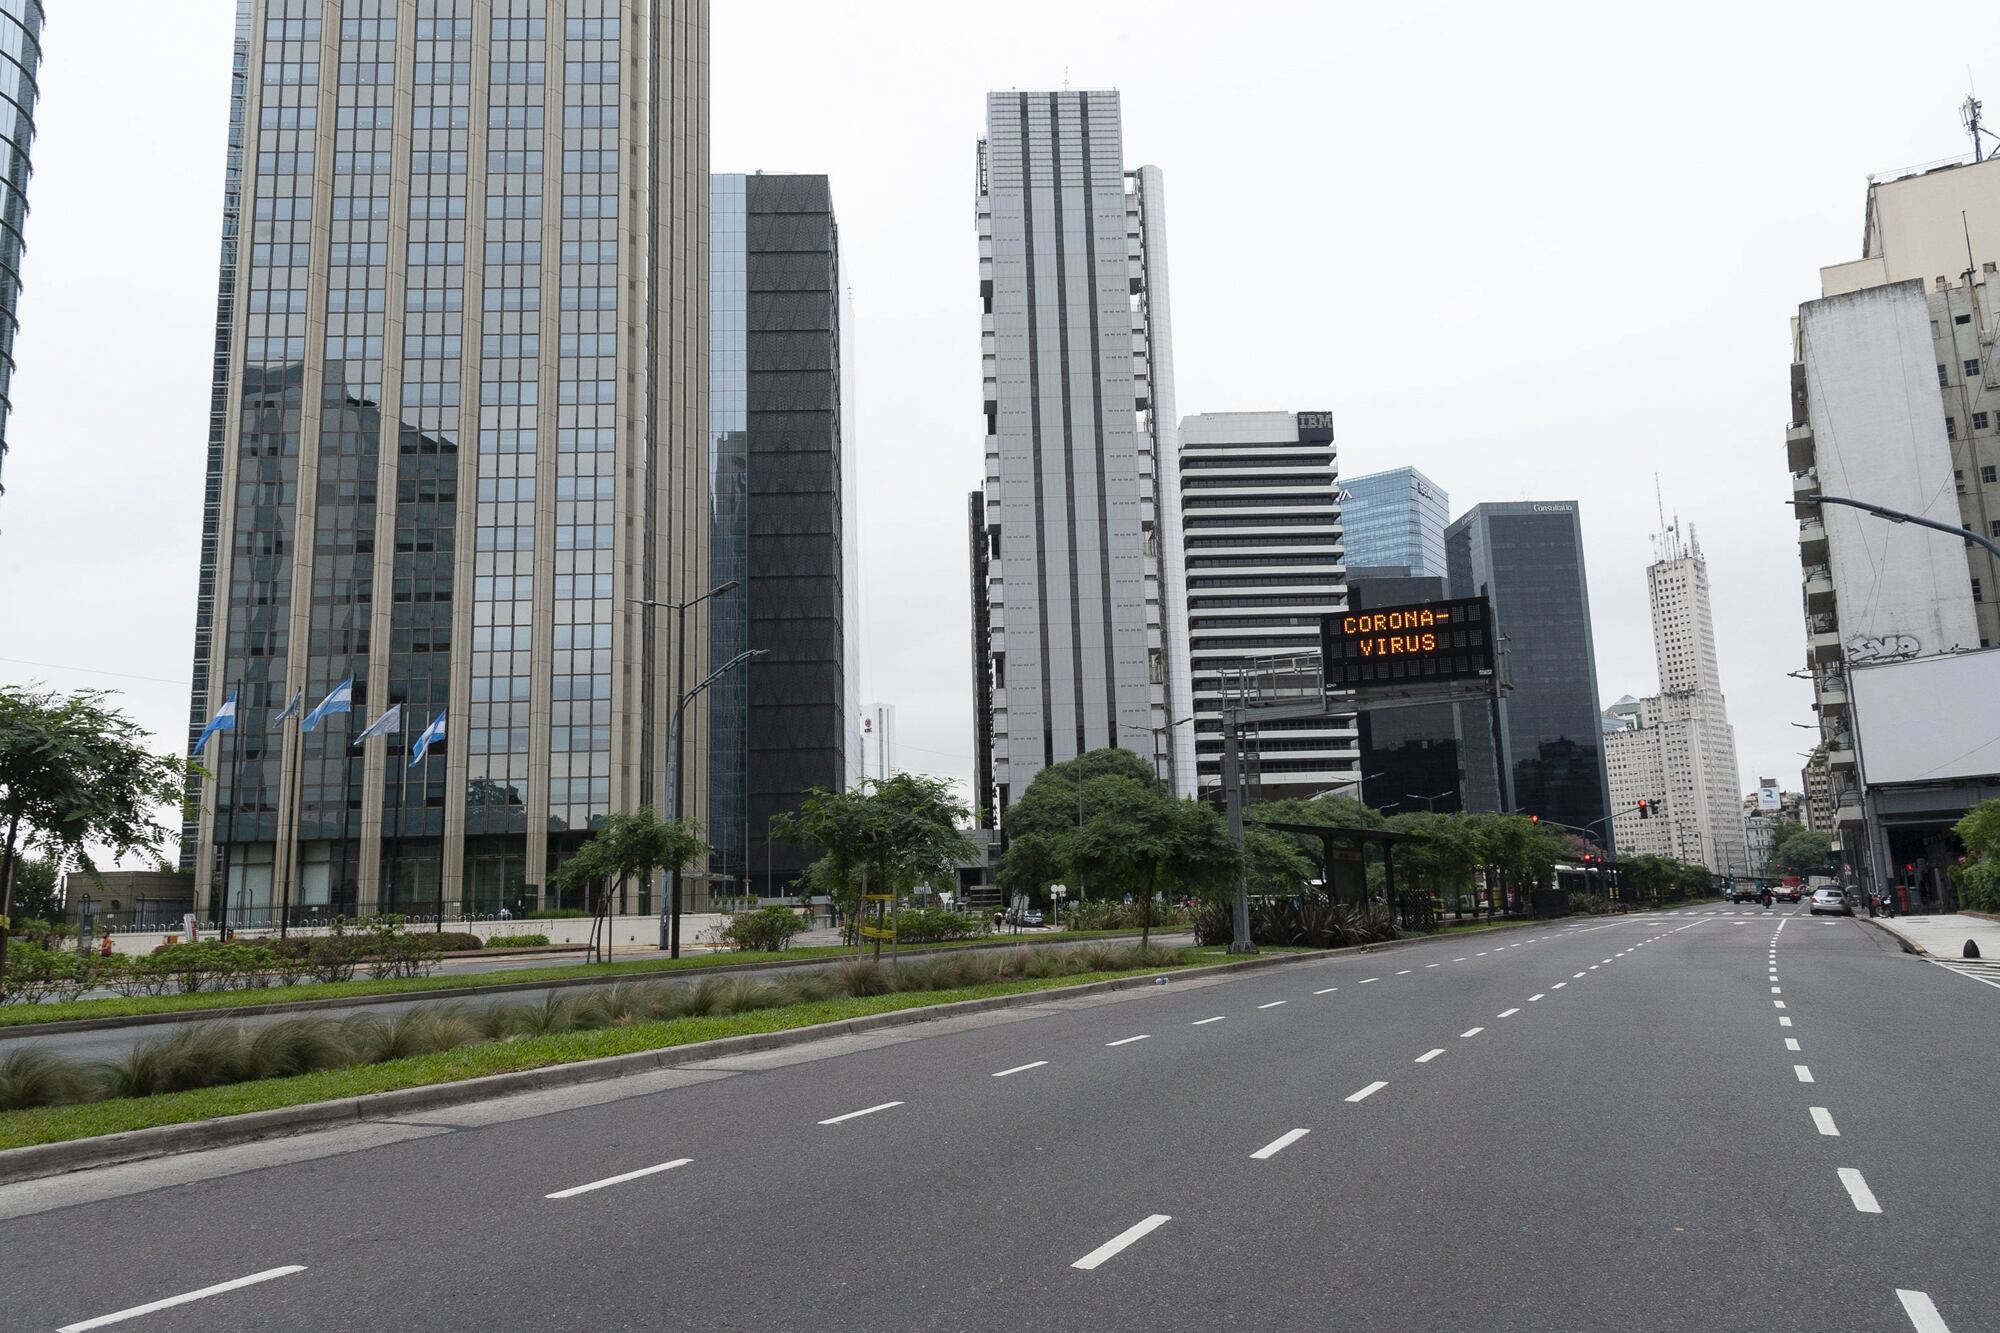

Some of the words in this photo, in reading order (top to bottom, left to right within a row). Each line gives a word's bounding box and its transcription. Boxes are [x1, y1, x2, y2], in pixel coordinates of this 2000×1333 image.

[1299, 414, 1332, 429] IBM
[1533, 503, 1573, 512] Consultatio
[1344, 609, 1449, 634] CORONA-
[1360, 633, 1436, 656] VIRUS
